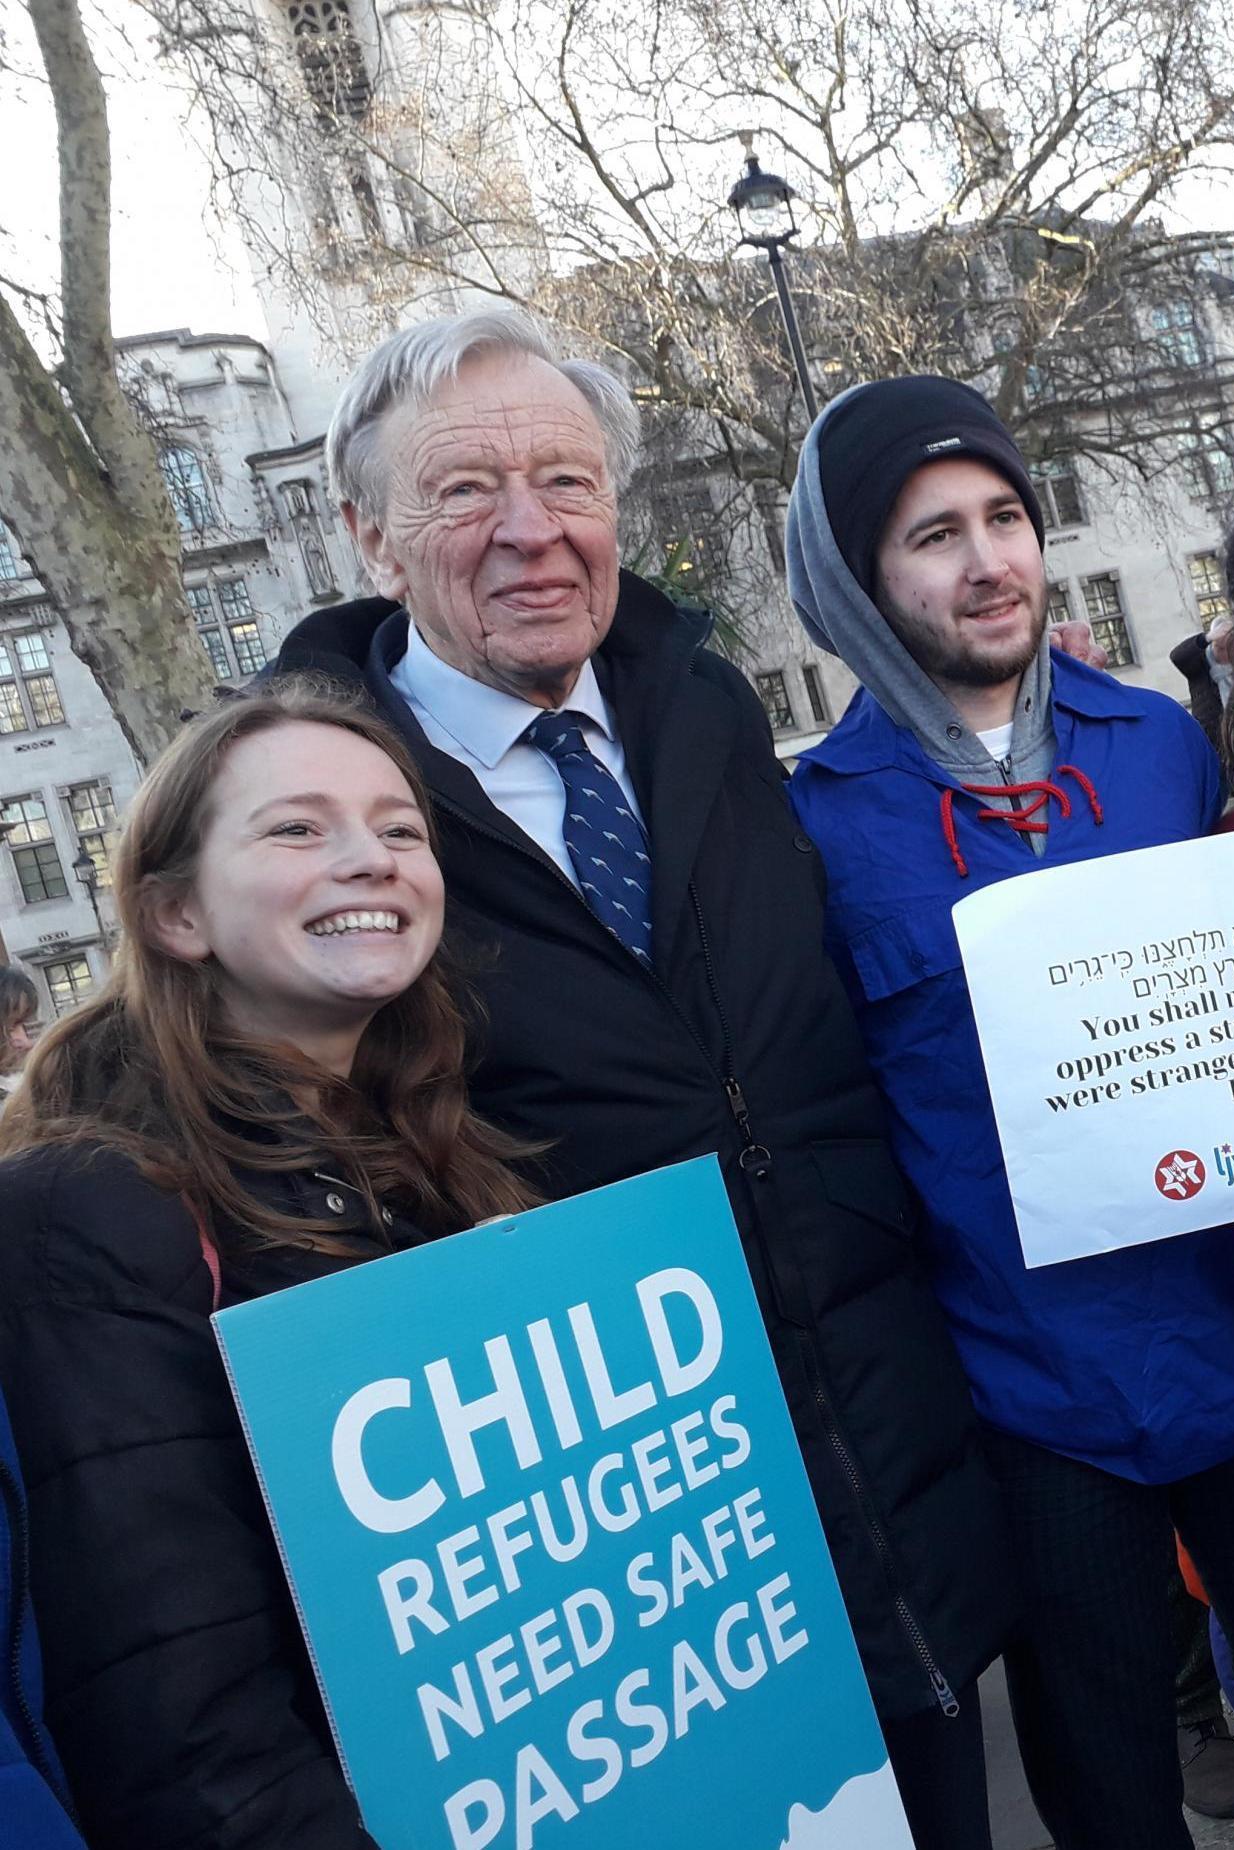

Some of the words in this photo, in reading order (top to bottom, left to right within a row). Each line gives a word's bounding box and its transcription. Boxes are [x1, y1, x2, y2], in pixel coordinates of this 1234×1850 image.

[1044, 1081, 1122, 1113] were
[1056, 1037, 1176, 1081] oppress
[1185, 1031, 1202, 1050] a
[1081, 1013, 1140, 1041] You
[1149, 990, 1219, 1026] shall
[331, 1267, 724, 1534] CHILD
[377, 1394, 752, 1656] REFUGEES
[416, 1587, 616, 1763] NEED
[626, 1487, 777, 1628] SAFE
[443, 1571, 810, 1850] PASSAGE
